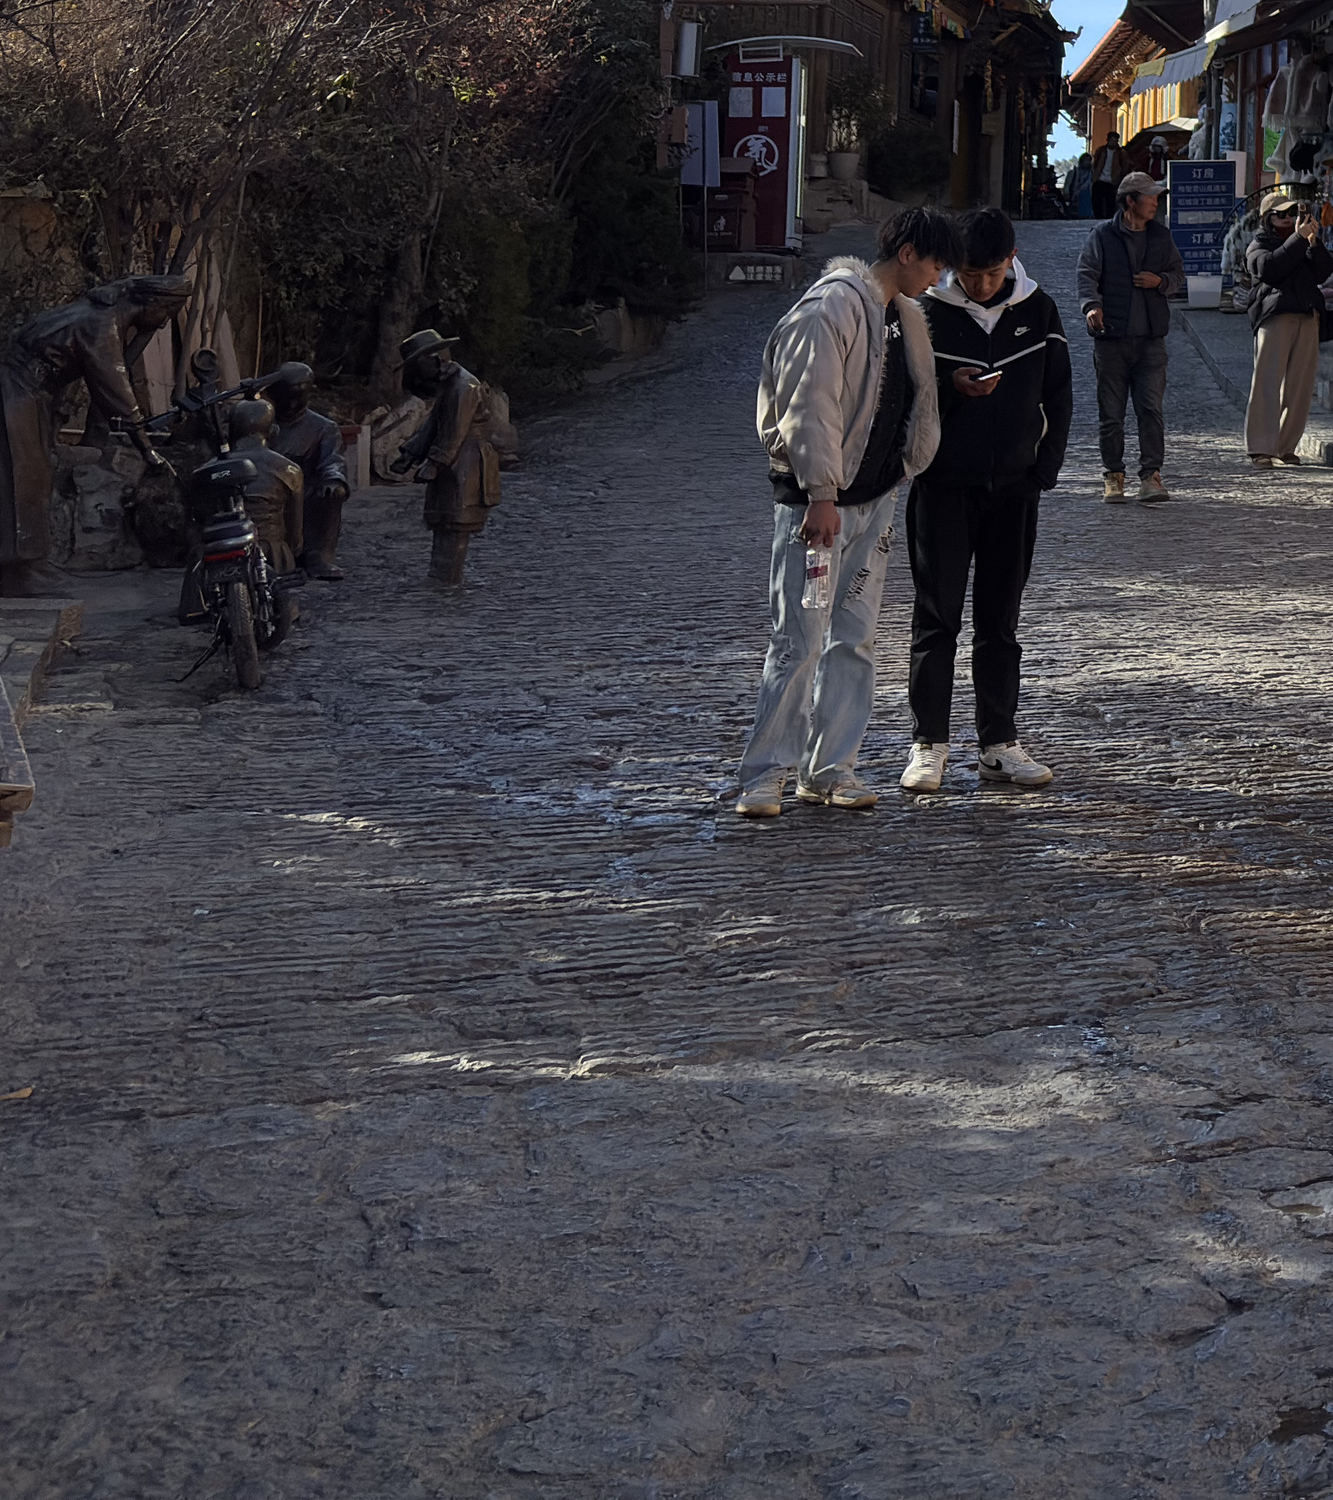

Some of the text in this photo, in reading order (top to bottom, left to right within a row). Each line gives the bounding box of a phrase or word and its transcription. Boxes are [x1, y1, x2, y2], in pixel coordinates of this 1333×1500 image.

[732, 72, 787, 83] 信息公示栏
[1192, 168, 1214, 179] 订房
[1191, 232, 1215, 244] 订票
